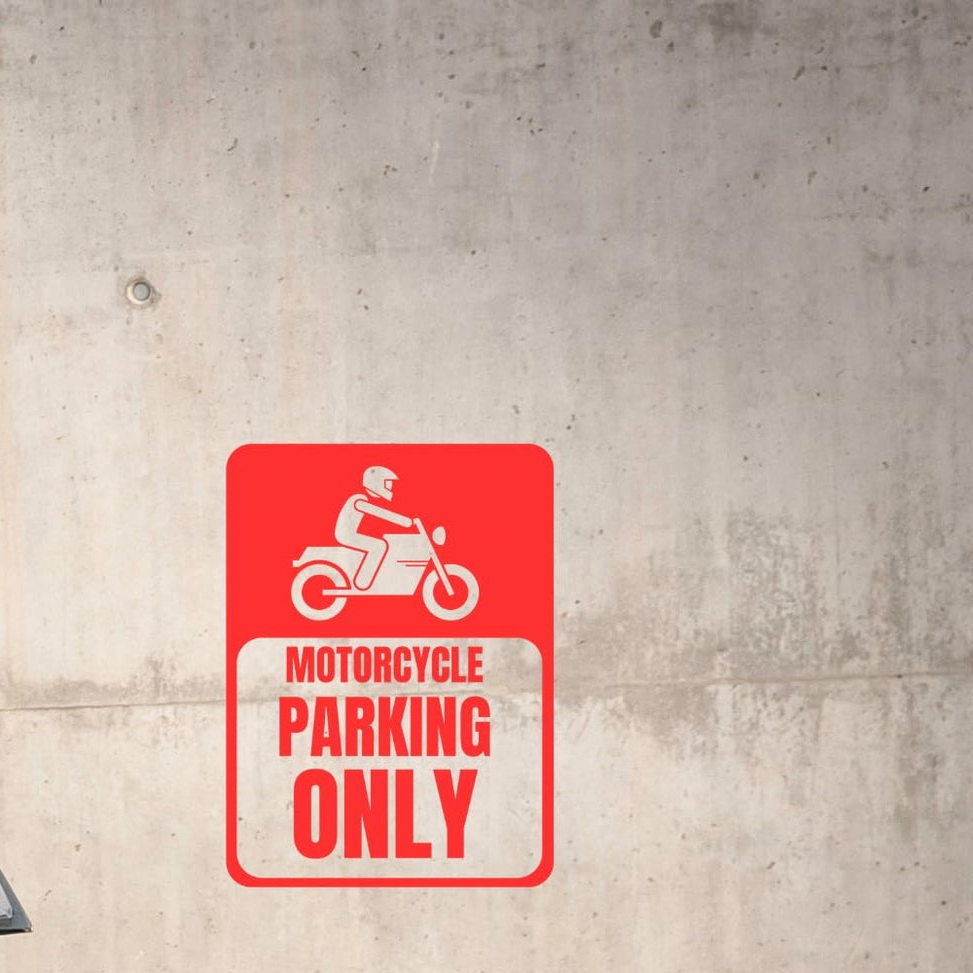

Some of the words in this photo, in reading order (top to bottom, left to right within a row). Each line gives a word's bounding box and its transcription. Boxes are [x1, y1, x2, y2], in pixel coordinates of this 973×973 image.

[286, 646, 483, 683] MOTORCYCLE
[279, 696, 491, 757] PARKING
[293, 768, 478, 859] ONLY
